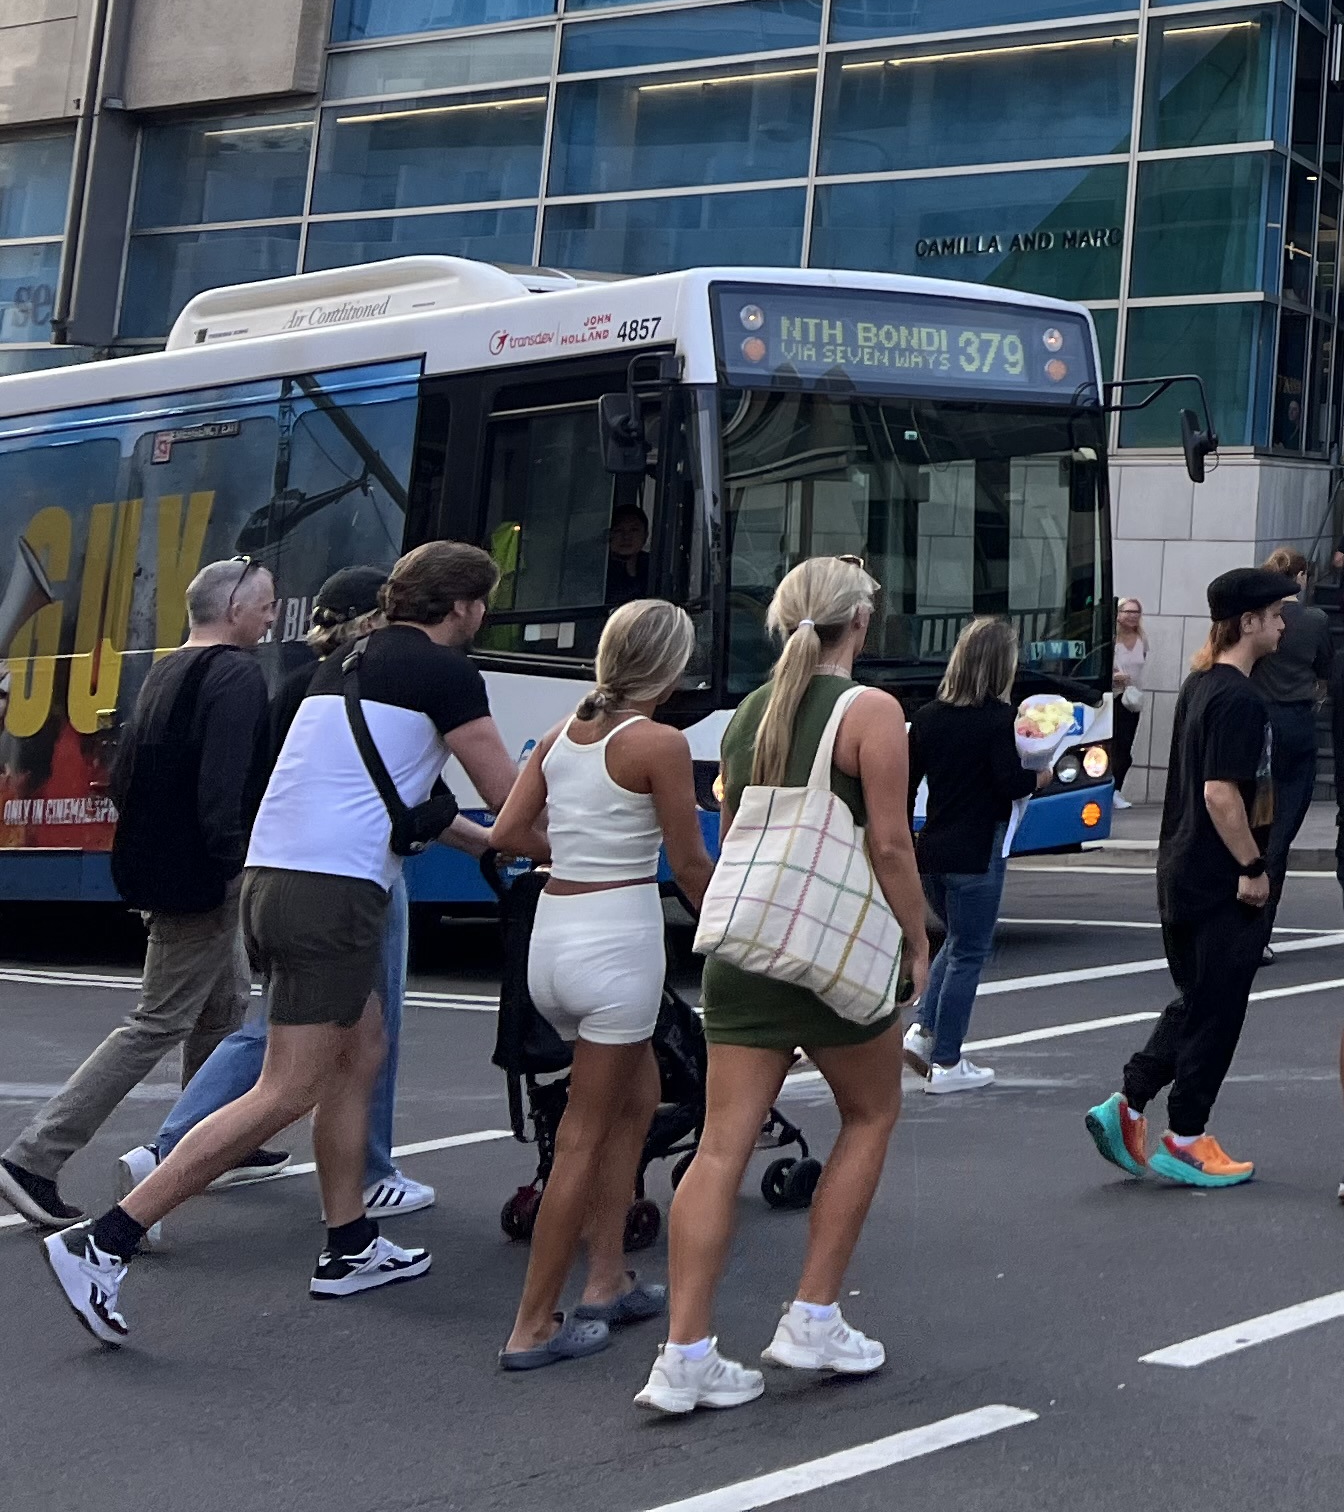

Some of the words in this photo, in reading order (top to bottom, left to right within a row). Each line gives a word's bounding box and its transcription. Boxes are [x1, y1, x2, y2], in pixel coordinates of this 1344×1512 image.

[915, 234, 1002, 258] CAMILLA
[1009, 231, 1055, 251] AND
[1062, 227, 1123, 249] MARC
[283, 310, 306, 330] Air
[308, 295, 392, 327] Conditioned
[584, 313, 612, 327] JOHN
[509, 331, 554, 350] transdev
[560, 329, 610, 345] HOLLAND
[616, 316, 662, 343] 4857
[780, 315, 843, 342] NTH
[857, 322, 949, 353] BONDI
[781, 342, 816, 362] VIA
[822, 346, 889, 367] SEVEN
[895, 352, 951, 371] WAYS
[957, 330, 1026, 376] 379
[32, 799, 44, 824] IN
